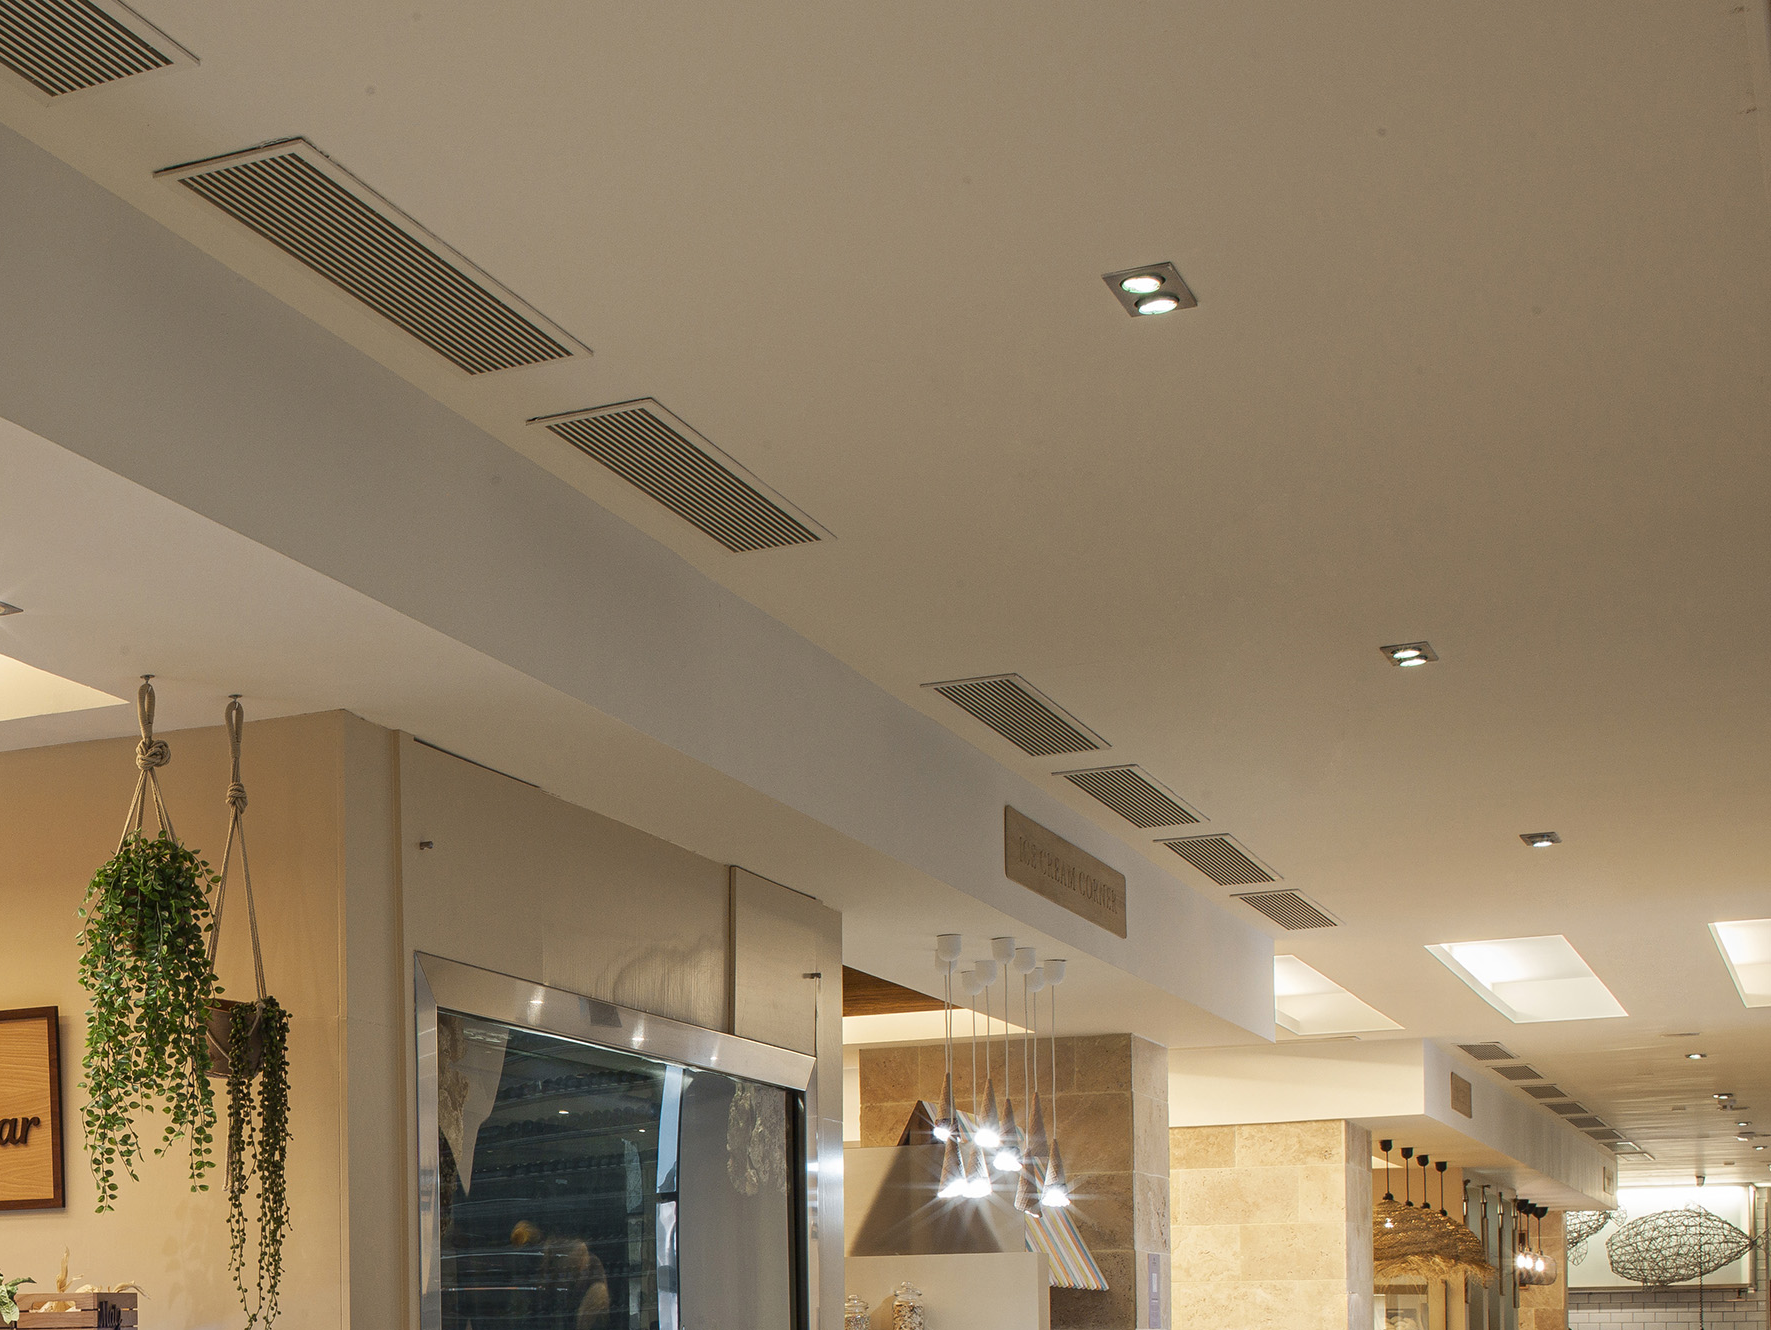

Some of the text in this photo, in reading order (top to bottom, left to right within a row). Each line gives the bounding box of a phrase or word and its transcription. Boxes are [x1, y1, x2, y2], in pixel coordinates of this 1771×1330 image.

[1018, 836, 1118, 915] ICE CREAM CORNER
